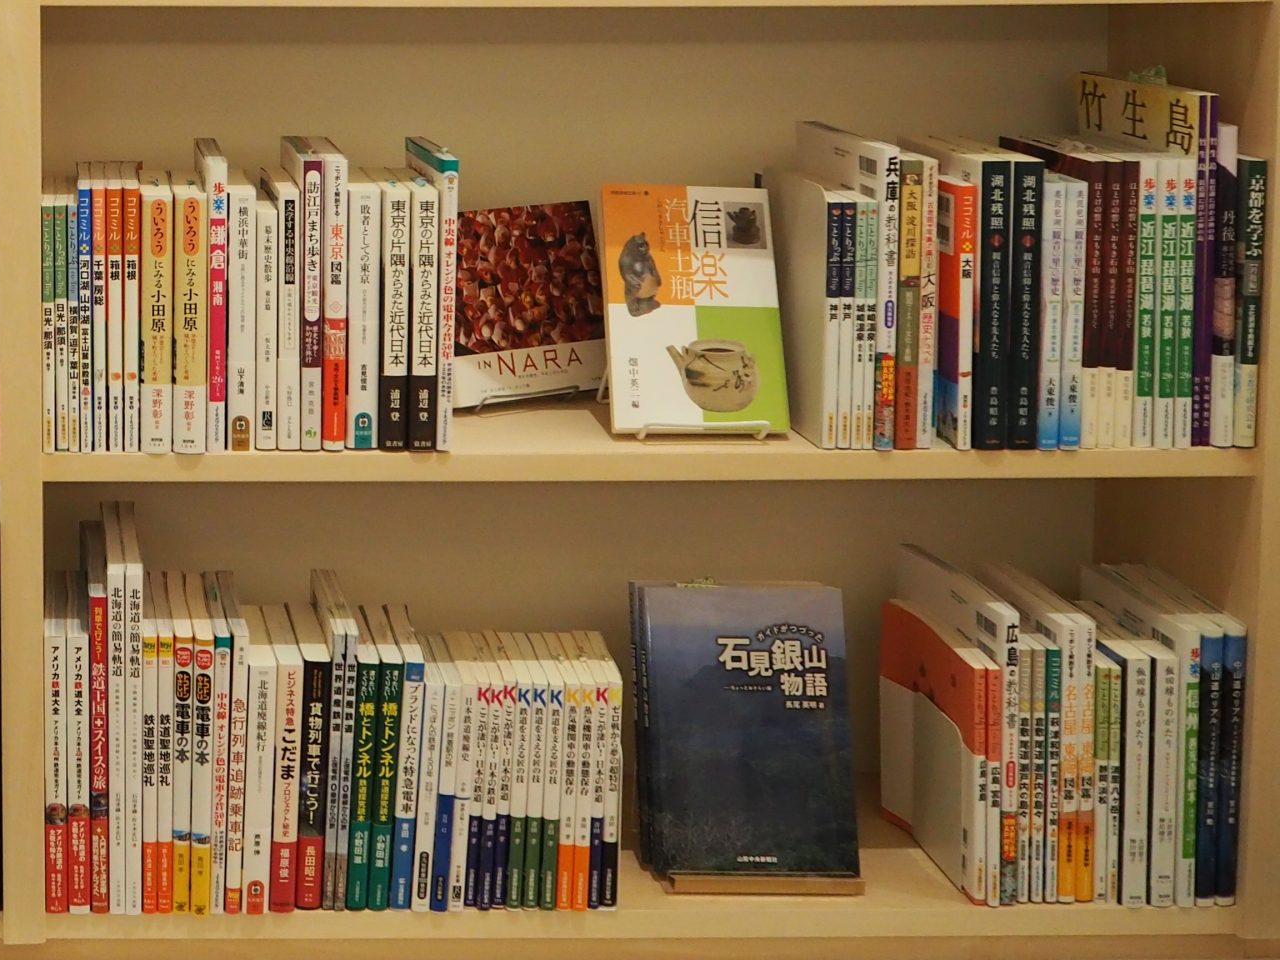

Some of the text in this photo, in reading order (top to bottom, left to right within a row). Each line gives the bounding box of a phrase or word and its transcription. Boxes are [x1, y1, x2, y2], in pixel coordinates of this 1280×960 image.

[1079, 79, 1195, 156] 竹生島
[79, 198, 91, 241] ココミル
[238, 206, 248, 260] 横浜中華街
[307, 181, 320, 272] 訪江戸まち歩き
[884, 155, 899, 267] 兵庫の教科書
[990, 174, 1005, 230] 湖北残照
[1246, 174, 1267, 257] 京都を学ぶ
[109, 260, 120, 280] 箱根
[210, 225, 226, 306] 鎌倉 湘南
[285, 202, 295, 284] 文学する中央線沿線
[360, 205, 371, 285] 敗者としての東京
[689, 199, 728, 300] 信楽
[961, 257, 972, 279] 大阪
[93, 260, 104, 306] 千葉 房総
[390, 199, 407, 368] 東京の片隅からみた近代日本
[477, 346, 584, 377] IN NARA
[111, 587, 123, 677] 北海道の簡易軌道
[716, 636, 828, 678] 石見銀山
[50, 646, 60, 716] アメリカ鉄道大全
[74, 646, 83, 716] アメリカ鉄道大全
[332, 662, 345, 733] 世界遺産鉄道
[779, 673, 828, 697] 物語
[1005, 624, 1020, 730] 広島の教科書
[143, 714, 156, 787] 鉄道聖地巡礼
[159, 714, 171, 787] 鉄道聖地巡礼
[174, 702, 191, 764] 電車の本
[255, 679, 269, 753] 北海道廃線紀行
[355, 702, 374, 778] 橋とトンネル
[400, 685, 421, 814] ブランドになった特急電車
[229, 698, 245, 852] 急行列車追跡乗車記
[279, 670, 298, 838] ビジネス特急 こだま プロジェクト秘史
[307, 702, 322, 824] 貨物列車で行こう!
[304, 846, 316, 887] 長田昭二
